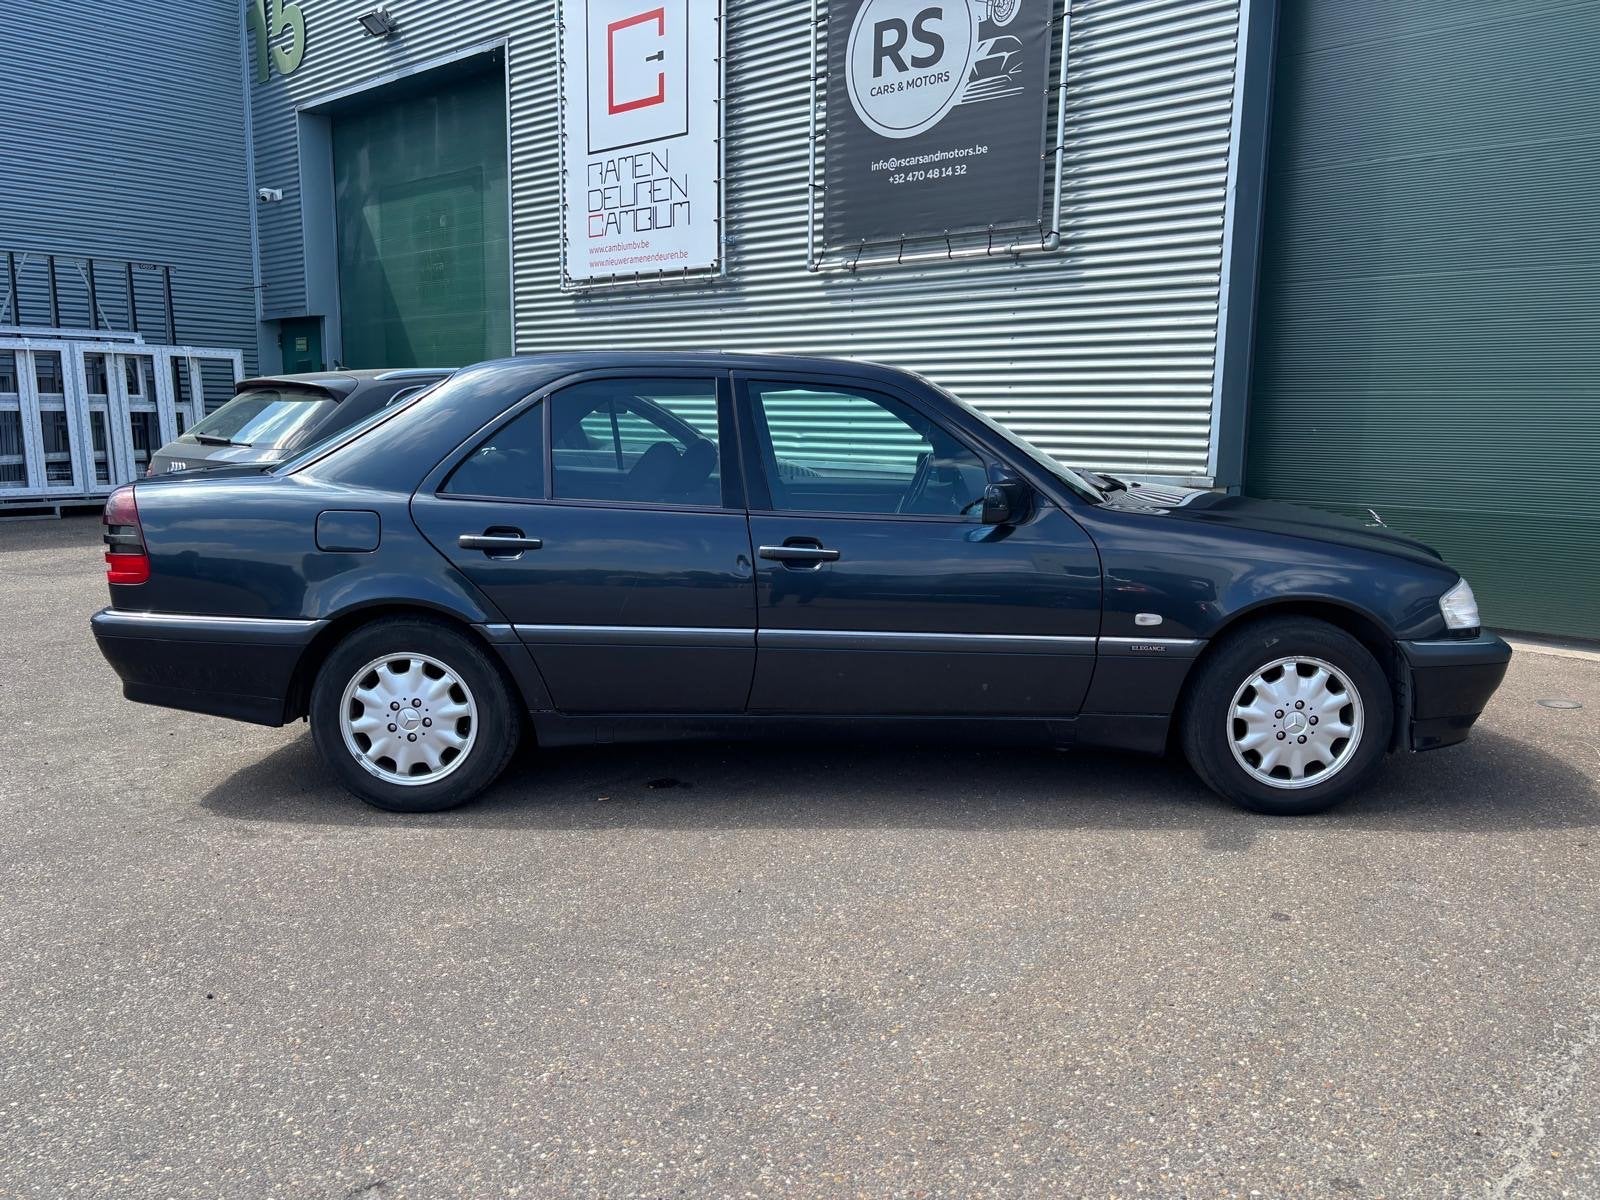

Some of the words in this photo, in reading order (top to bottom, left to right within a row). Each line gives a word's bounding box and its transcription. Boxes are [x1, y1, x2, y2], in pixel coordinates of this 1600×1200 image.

[872, 7, 945, 78] RS
[870, 83, 895, 97] CARS
[897, 81, 904, 92] &
[906, 71, 950, 90] MOTORS
[587, 148, 669, 187] RAMEN
[871, 144, 988, 171] info@rscarsandmotors.be
[888, 173, 905, 184] +32
[906, 170, 925, 182] 470
[927, 168, 940, 179] 48
[941, 166, 952, 177] 14
[954, 164, 967, 176] 32
[587, 173, 688, 213] DEUREN
[588, 200, 690, 238] CAMBIUM
[589, 240, 650, 254] www.cambiumbv.be
[589, 249, 689, 268] www.nieuweramenendeuren.be
